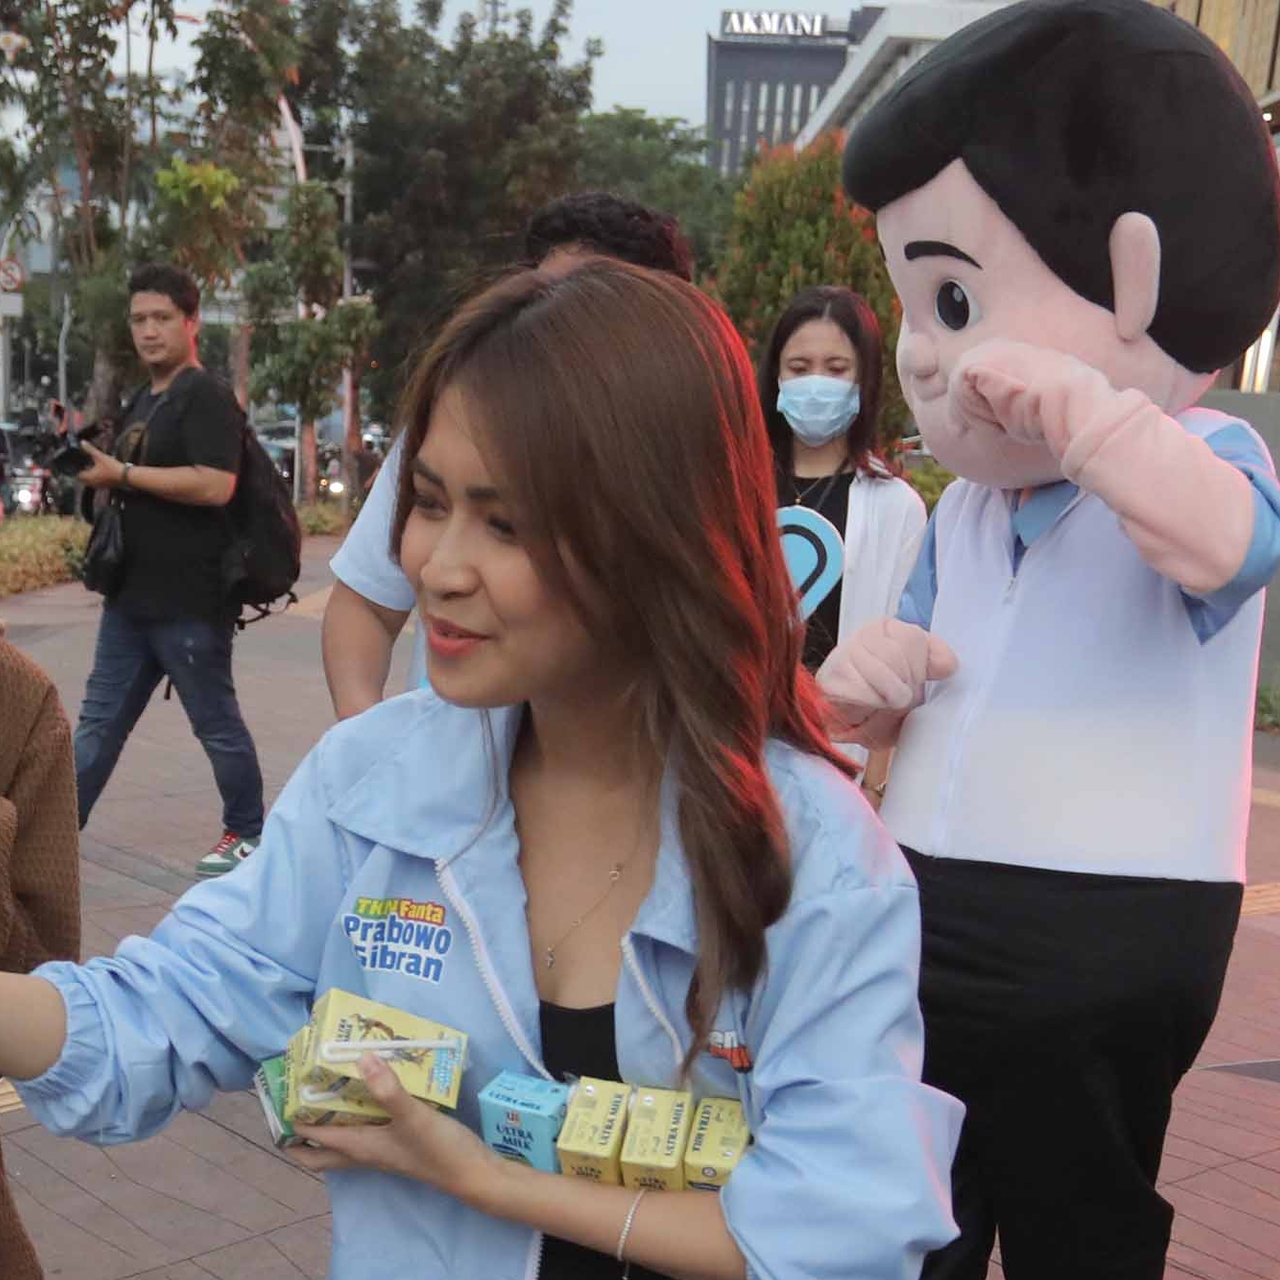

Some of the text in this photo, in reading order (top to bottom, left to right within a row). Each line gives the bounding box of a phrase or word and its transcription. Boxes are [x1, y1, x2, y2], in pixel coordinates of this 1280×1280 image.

[723, 11, 822, 36] AKMANI
[400, 900, 444, 924] Fanta
[344, 914, 452, 955] Prabowo
[599, 1093, 625, 1146] ULTRA MILK
[664, 1102, 685, 1156] ULTRA MILK
[495, 1123, 534, 1142] ULTRA
[502, 1135, 534, 1152] MILK
